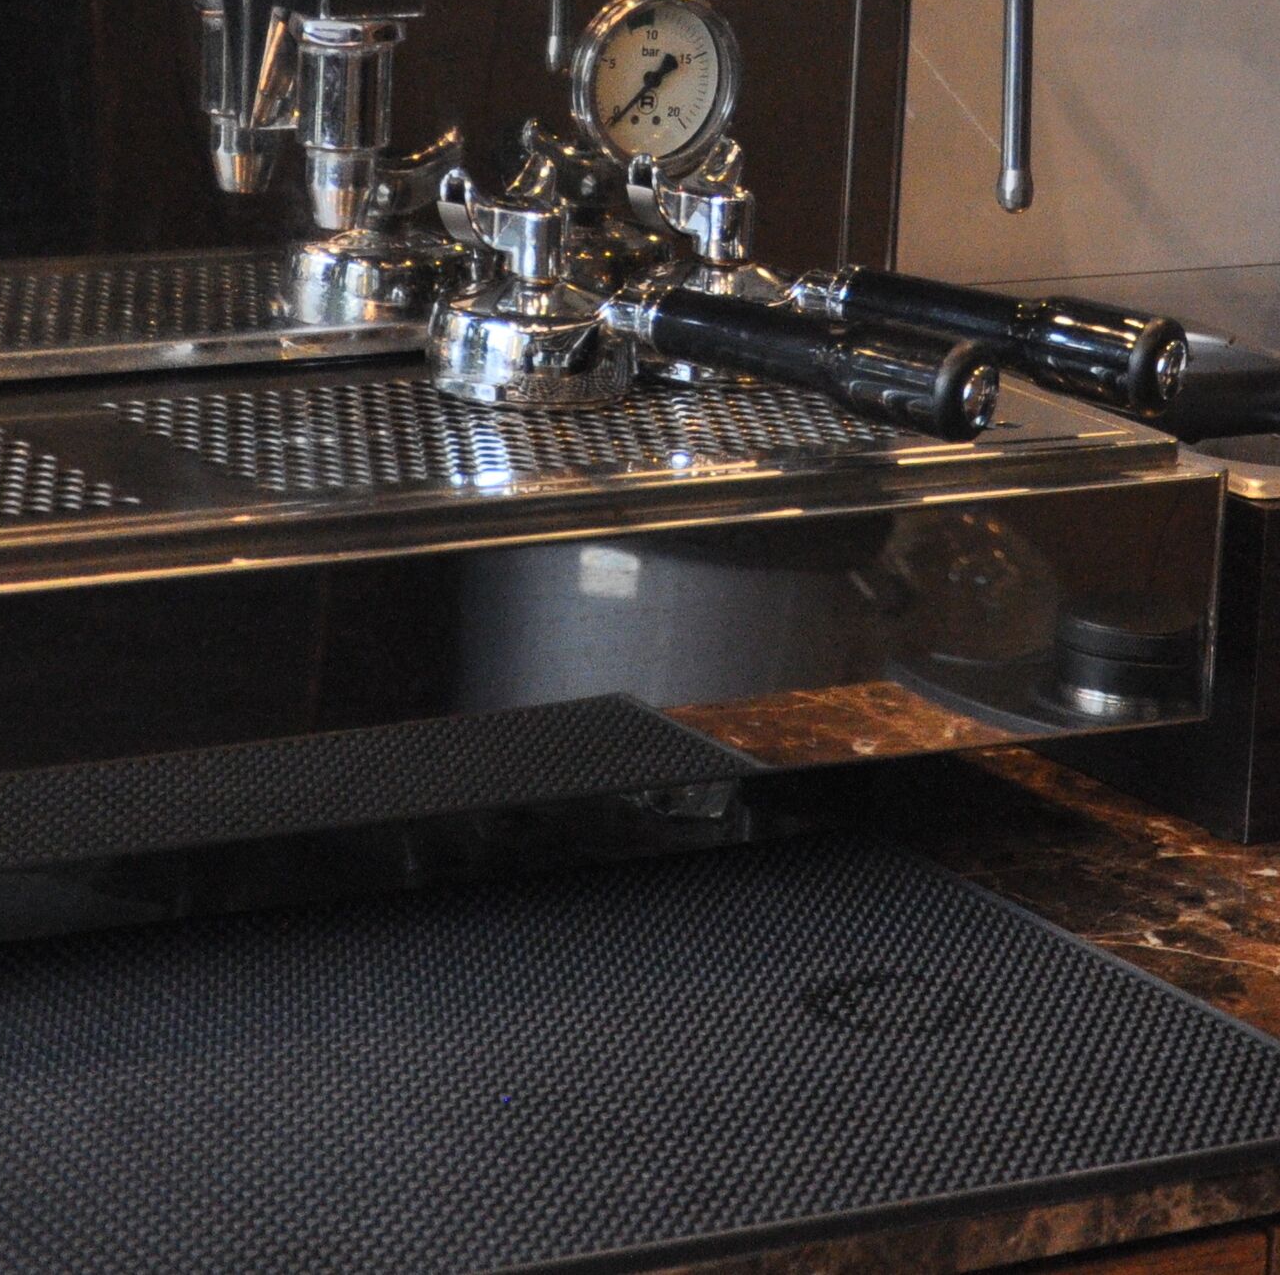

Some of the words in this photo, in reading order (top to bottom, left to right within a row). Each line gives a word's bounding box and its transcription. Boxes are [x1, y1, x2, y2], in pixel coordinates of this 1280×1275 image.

[645, 29, 659, 41] 10
[641, 46, 661, 58] bar
[608, 58, 617, 70] 5
[680, 53, 692, 65] 15
[667, 106, 681, 118] 20
